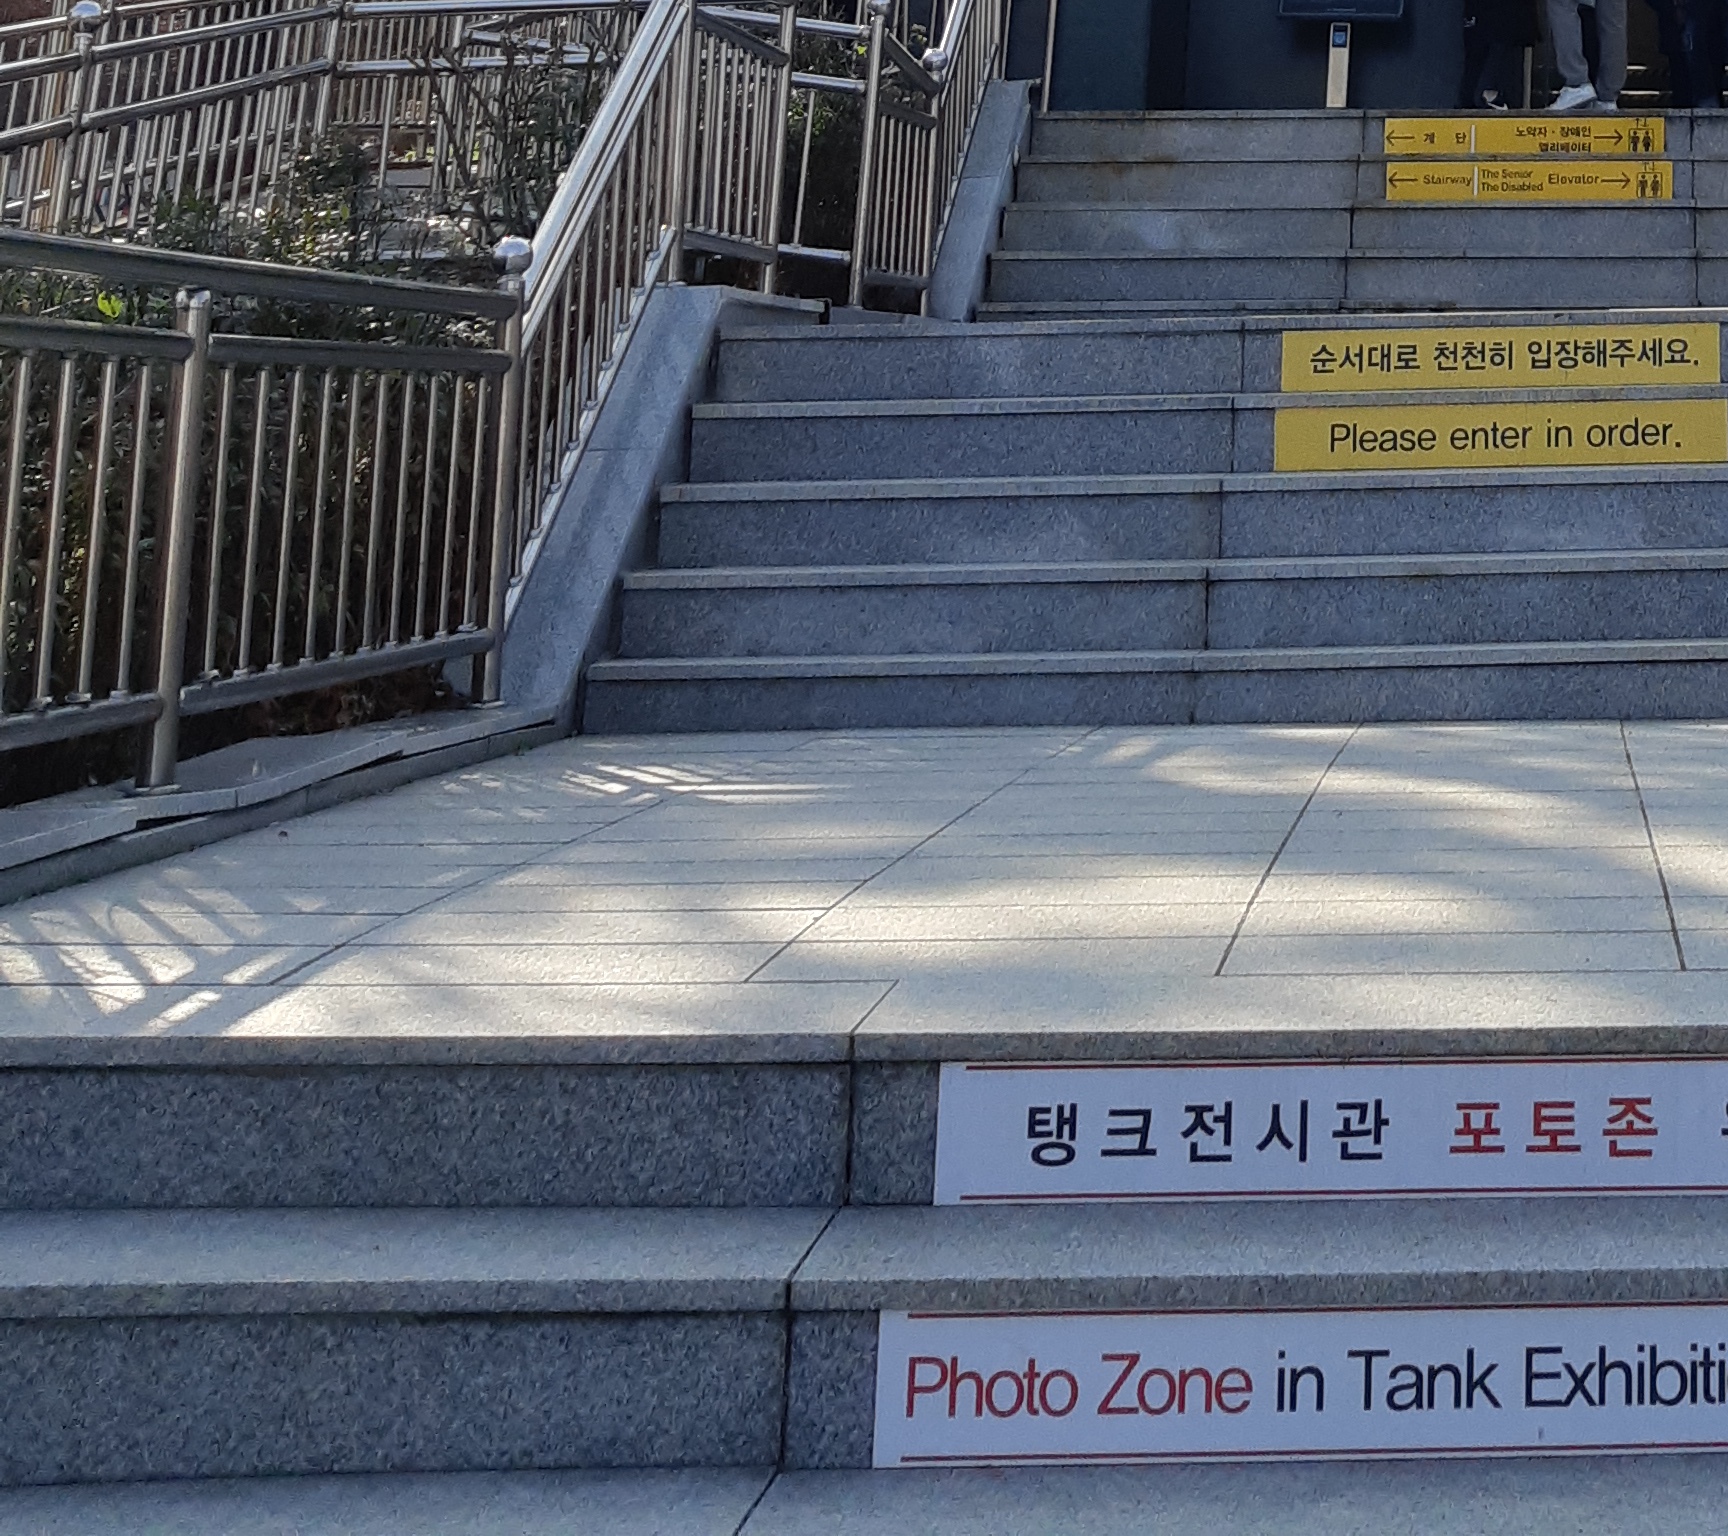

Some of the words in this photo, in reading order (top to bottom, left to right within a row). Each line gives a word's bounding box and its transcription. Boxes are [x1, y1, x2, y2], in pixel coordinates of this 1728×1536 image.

[1515, 126, 1547, 138] 노약자
[1559, 126, 1591, 138] 장애인
[1423, 174, 1472, 187] Stairway
[1481, 169, 1499, 179] The
[1548, 173, 1599, 185] Elevator
[1481, 182, 1499, 192] The
[1310, 344, 1421, 374] 순서대로
[1433, 340, 1515, 372] 천천히
[1527, 337, 1700, 370] 입장해주세요.
[1330, 422, 1437, 454] Please
[1449, 421, 1533, 451] enter
[1546, 418, 1574, 449] in
[1586, 417, 1683, 449] order.
[1027, 1097, 1390, 1166] 탱크전시관
[1448, 1095, 1660, 1159] 포토존
[905, 1355, 1077, 1419] Photo
[1096, 1352, 1253, 1416] Zone
[1276, 1351, 1325, 1413] in
[1346, 1346, 1497, 1411] Tank
